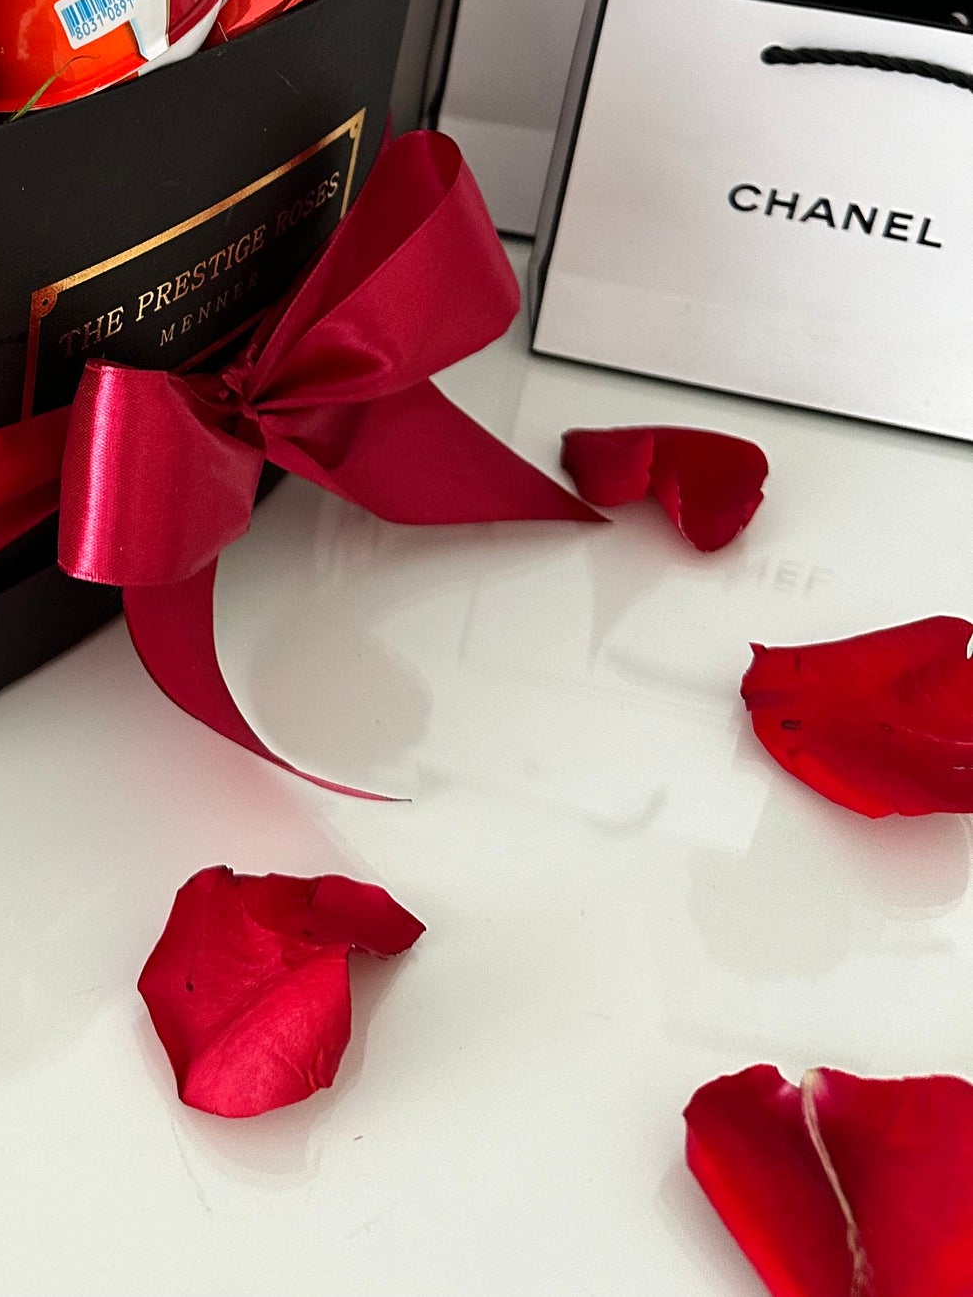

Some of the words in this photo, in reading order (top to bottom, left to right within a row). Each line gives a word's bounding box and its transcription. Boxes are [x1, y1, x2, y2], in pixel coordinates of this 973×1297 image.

[59, 306, 125, 358] THE
[135, 224, 267, 322] PRESTIGE
[274, 171, 340, 239] ROSES
[727, 183, 943, 249] CHANEL
